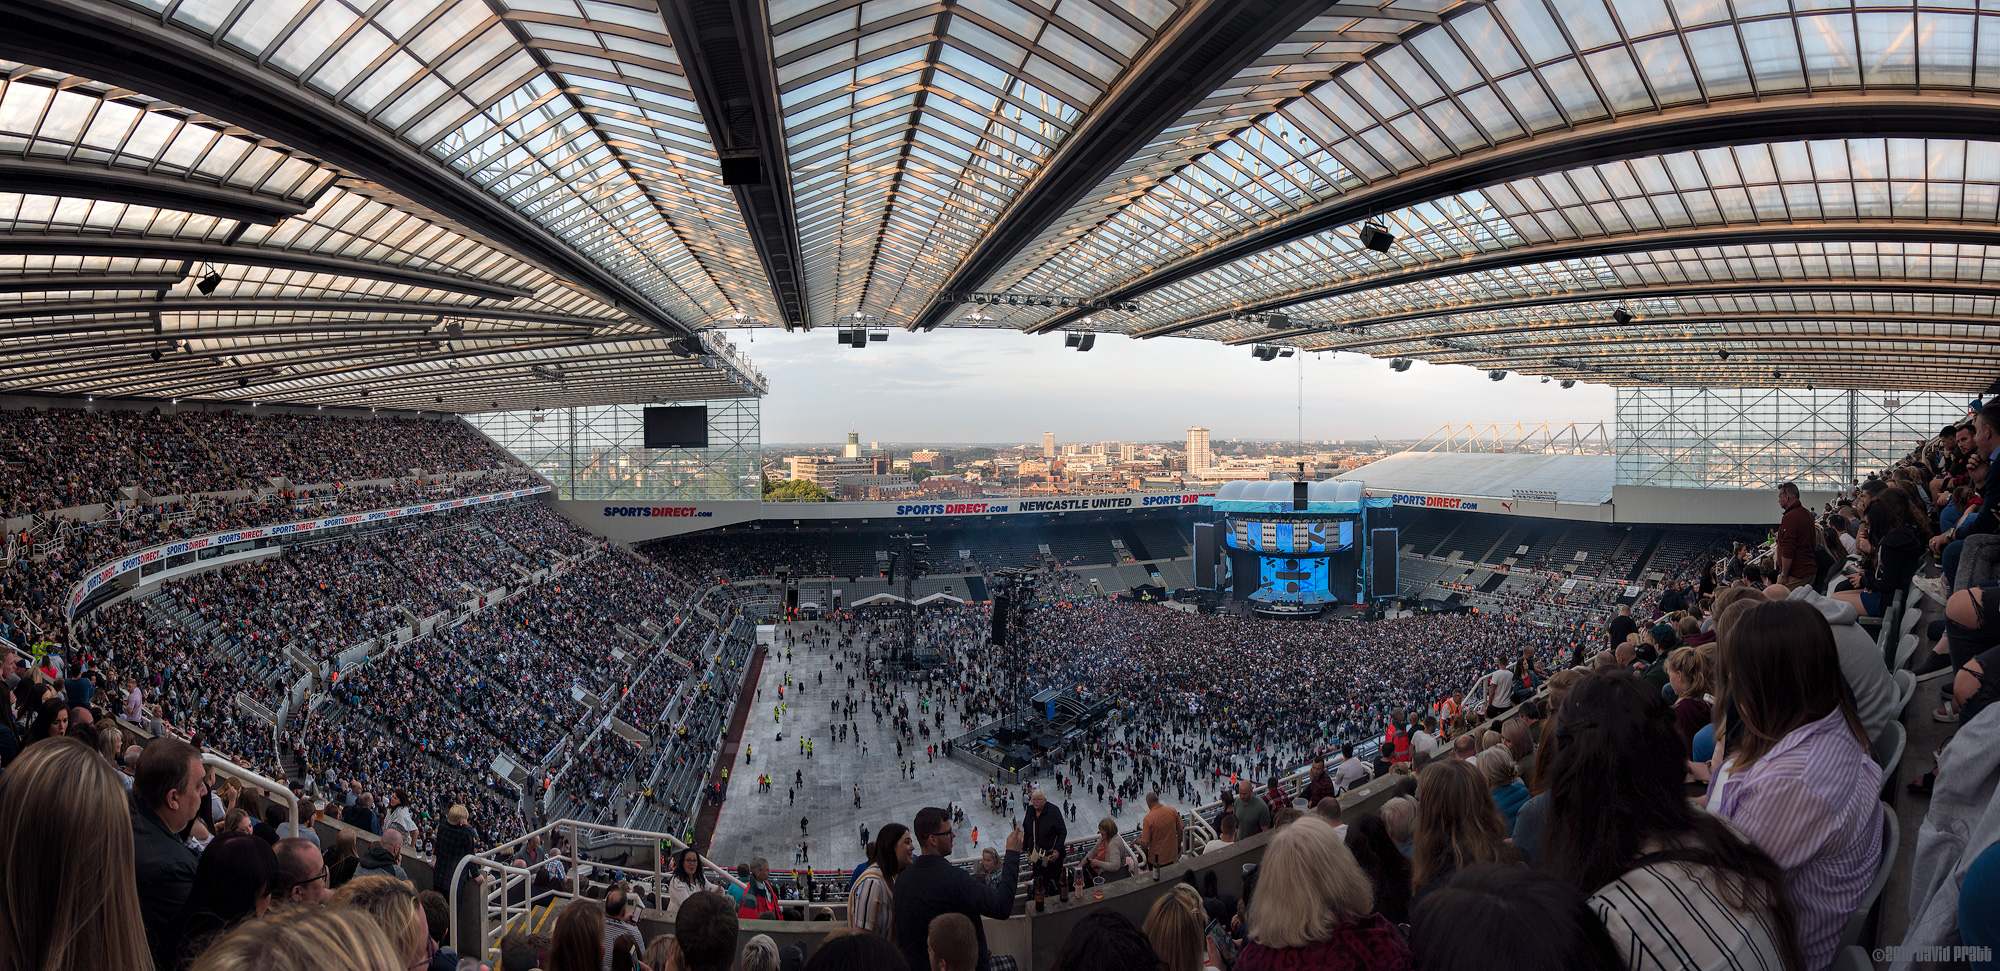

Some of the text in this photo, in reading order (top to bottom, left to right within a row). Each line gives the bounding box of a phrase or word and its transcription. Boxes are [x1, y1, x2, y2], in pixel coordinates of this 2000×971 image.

[1019, 498, 1132, 512] NEWCASTLE UNITED
[1142, 493, 1215, 506] SPORTSDIR
[406, 504, 438, 514] SPORTSDIRECT.
[603, 506, 713, 518] SPORTSDIRECT.COM
